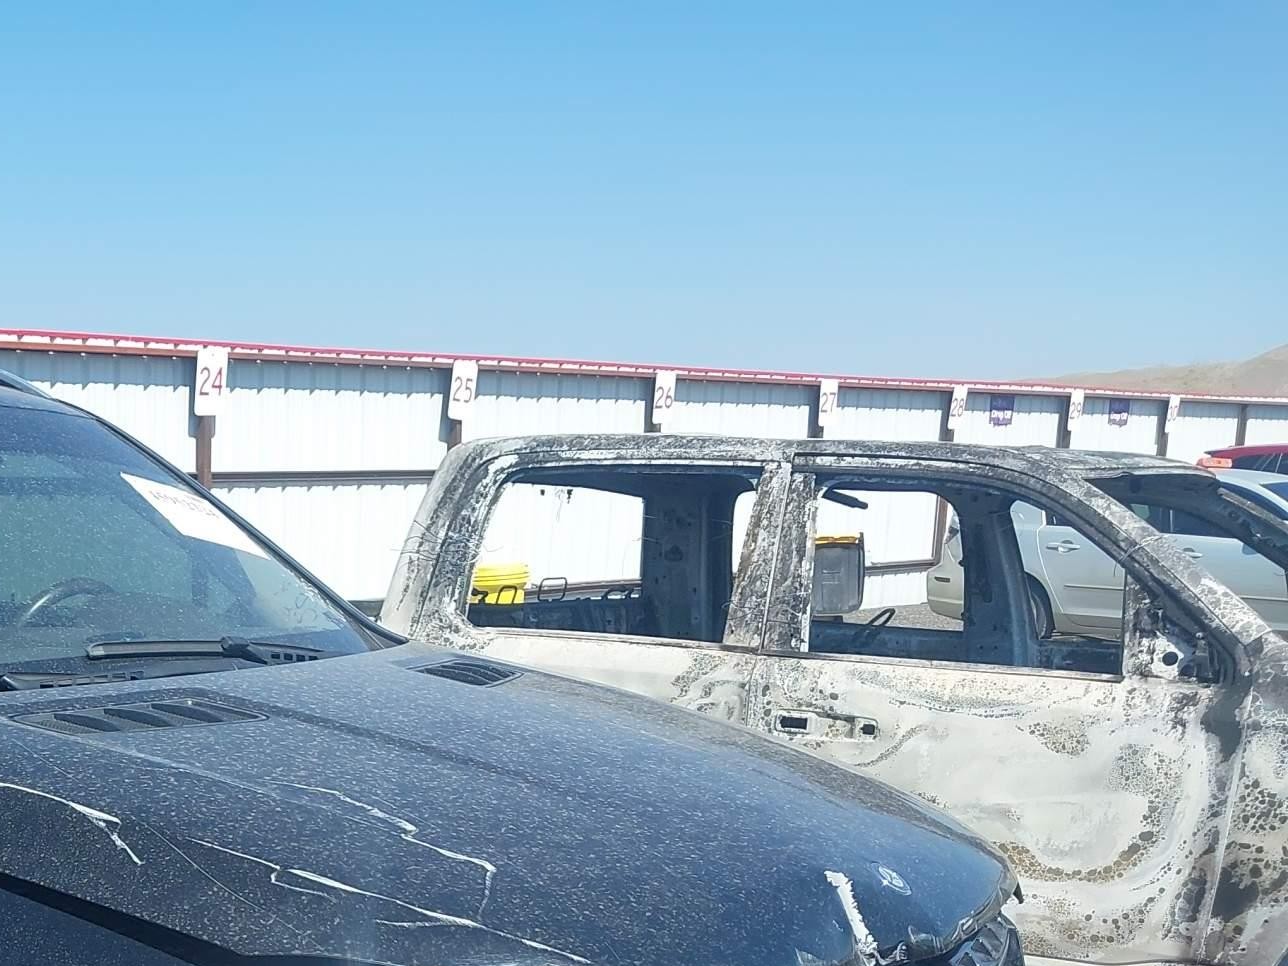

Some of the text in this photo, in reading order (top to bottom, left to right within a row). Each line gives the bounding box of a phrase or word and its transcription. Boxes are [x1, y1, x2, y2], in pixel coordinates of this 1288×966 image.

[199, 366, 223, 396] 24
[452, 375, 474, 403] 25
[654, 386, 673, 409] 26
[820, 391, 837, 413] 27
[951, 397, 965, 417] 28
[1069, 401, 1082, 420] 29
